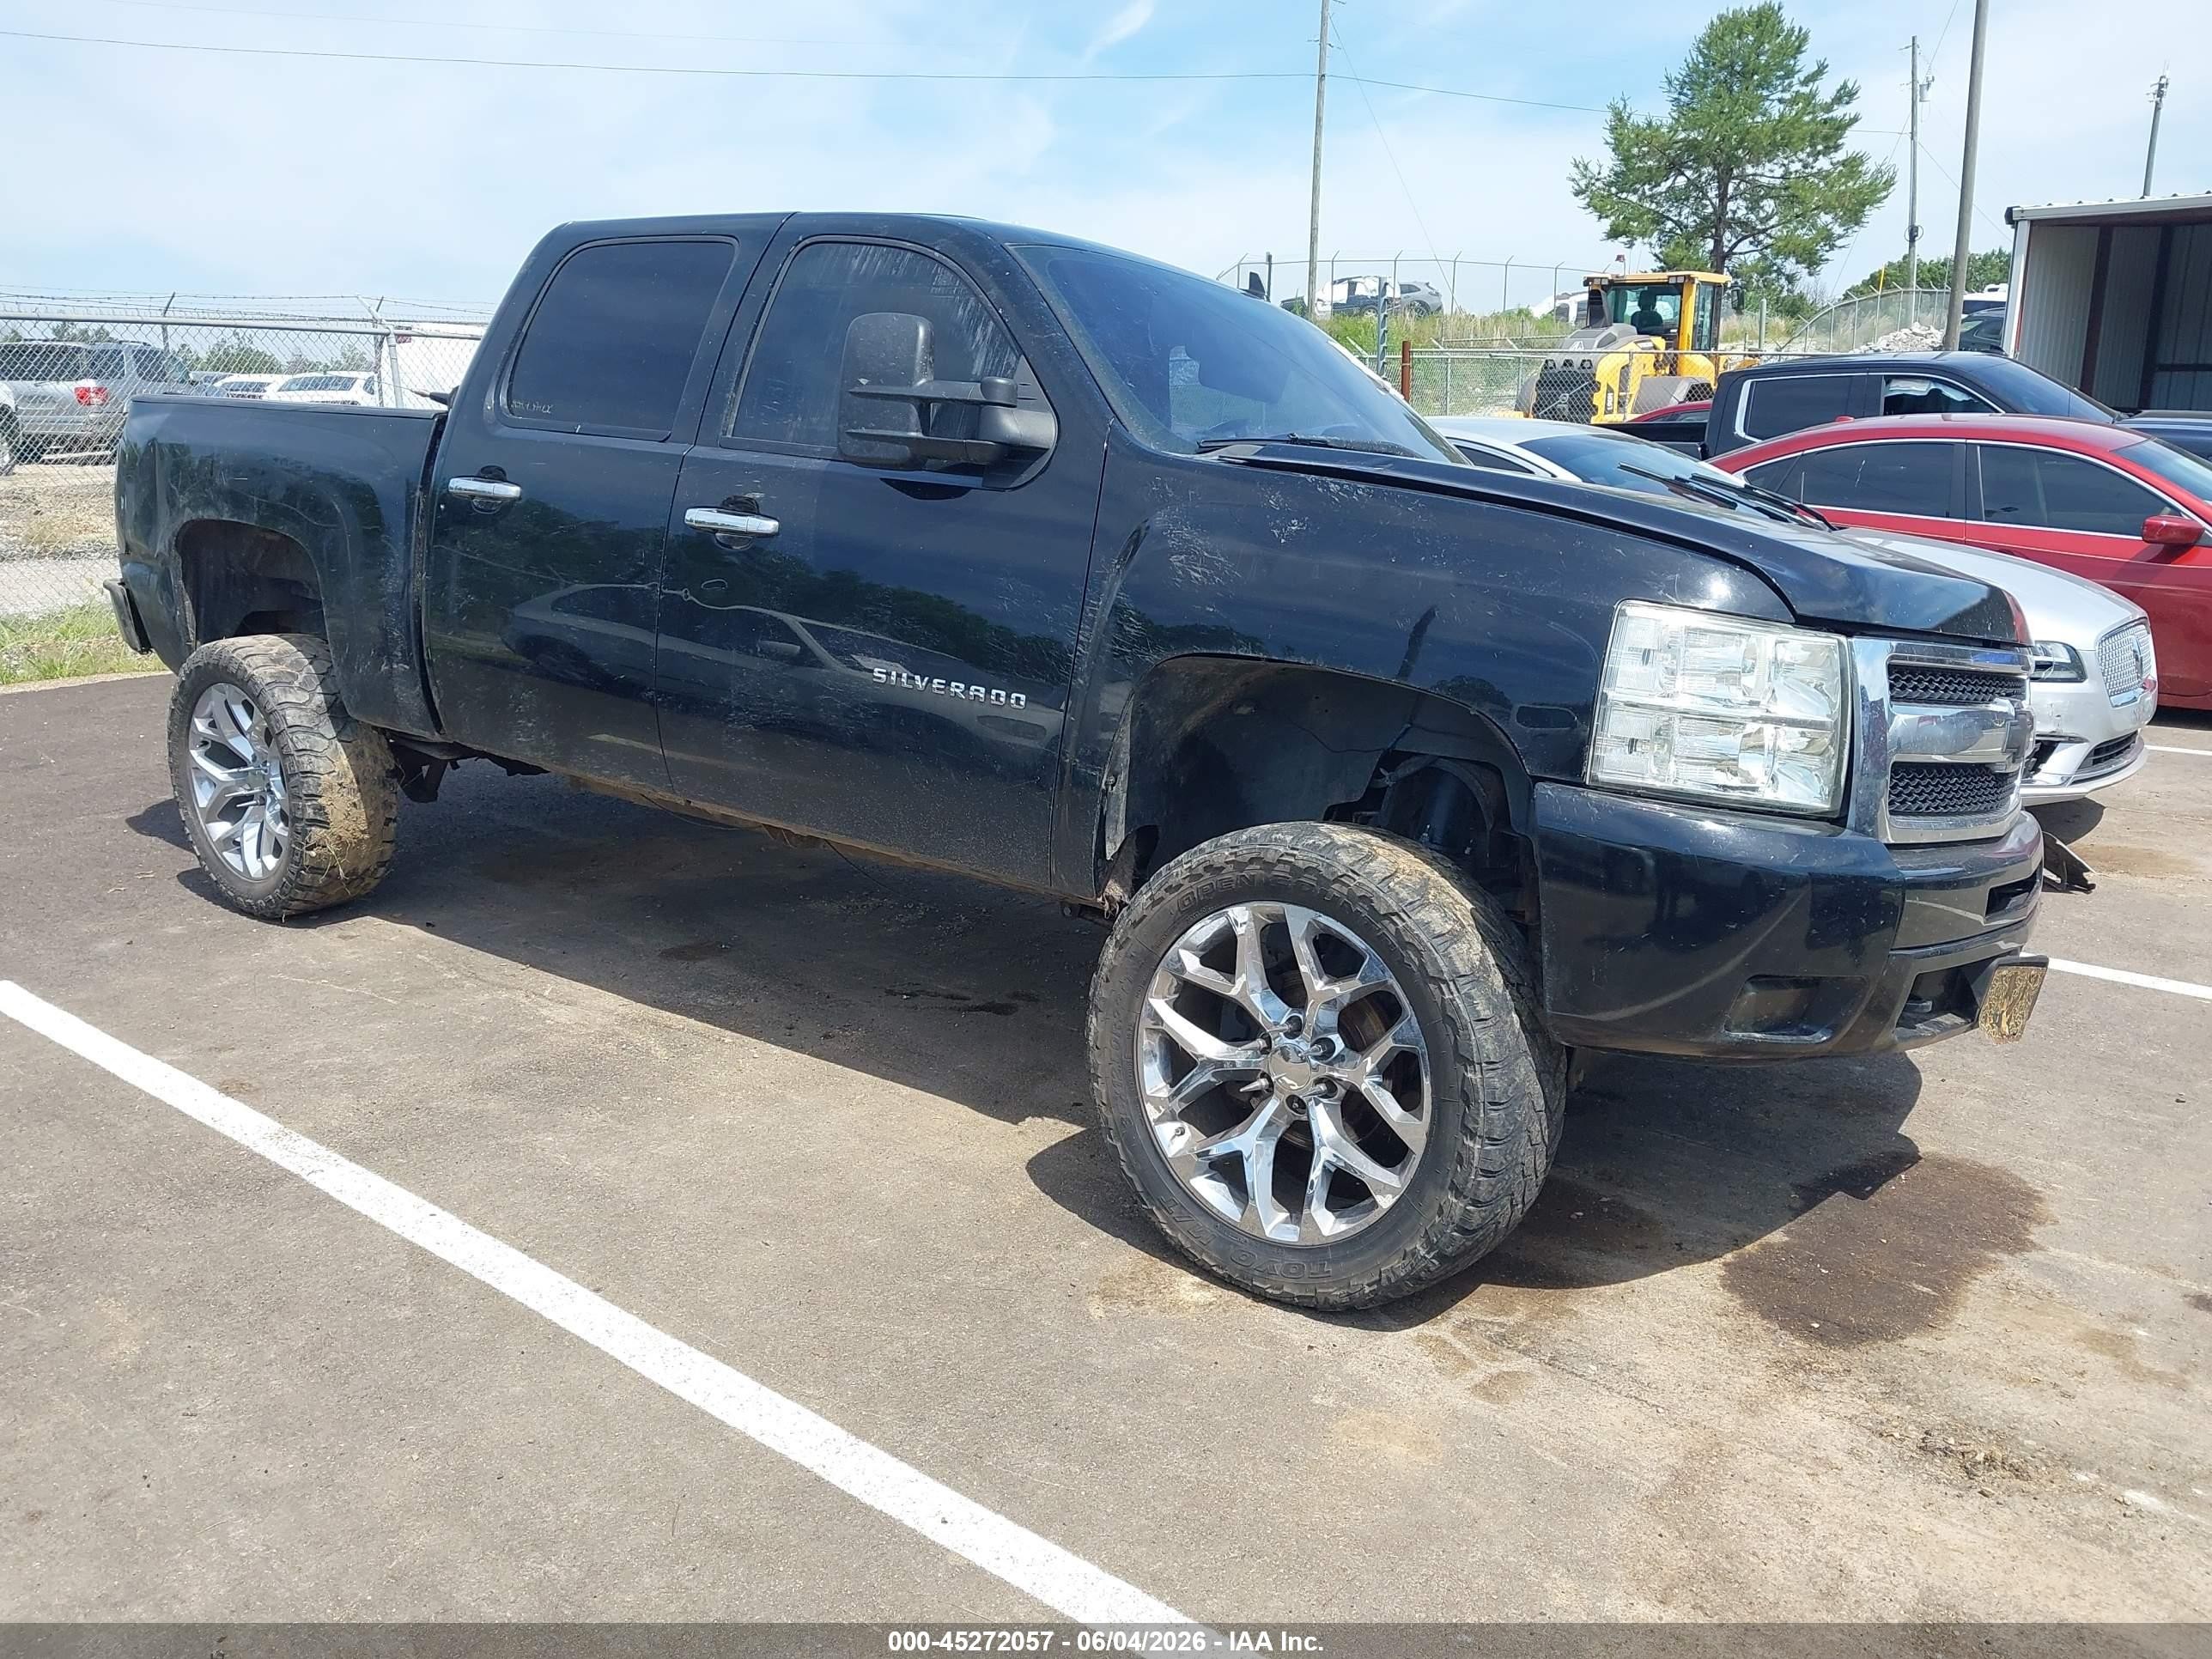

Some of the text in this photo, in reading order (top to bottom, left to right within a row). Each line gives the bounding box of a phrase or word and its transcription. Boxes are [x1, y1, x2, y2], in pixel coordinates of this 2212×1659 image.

[872, 667, 1026, 709] SILVERADO
[1177, 872, 1257, 914] OPEN
[1230, 1249, 1332, 1279] TOYO
